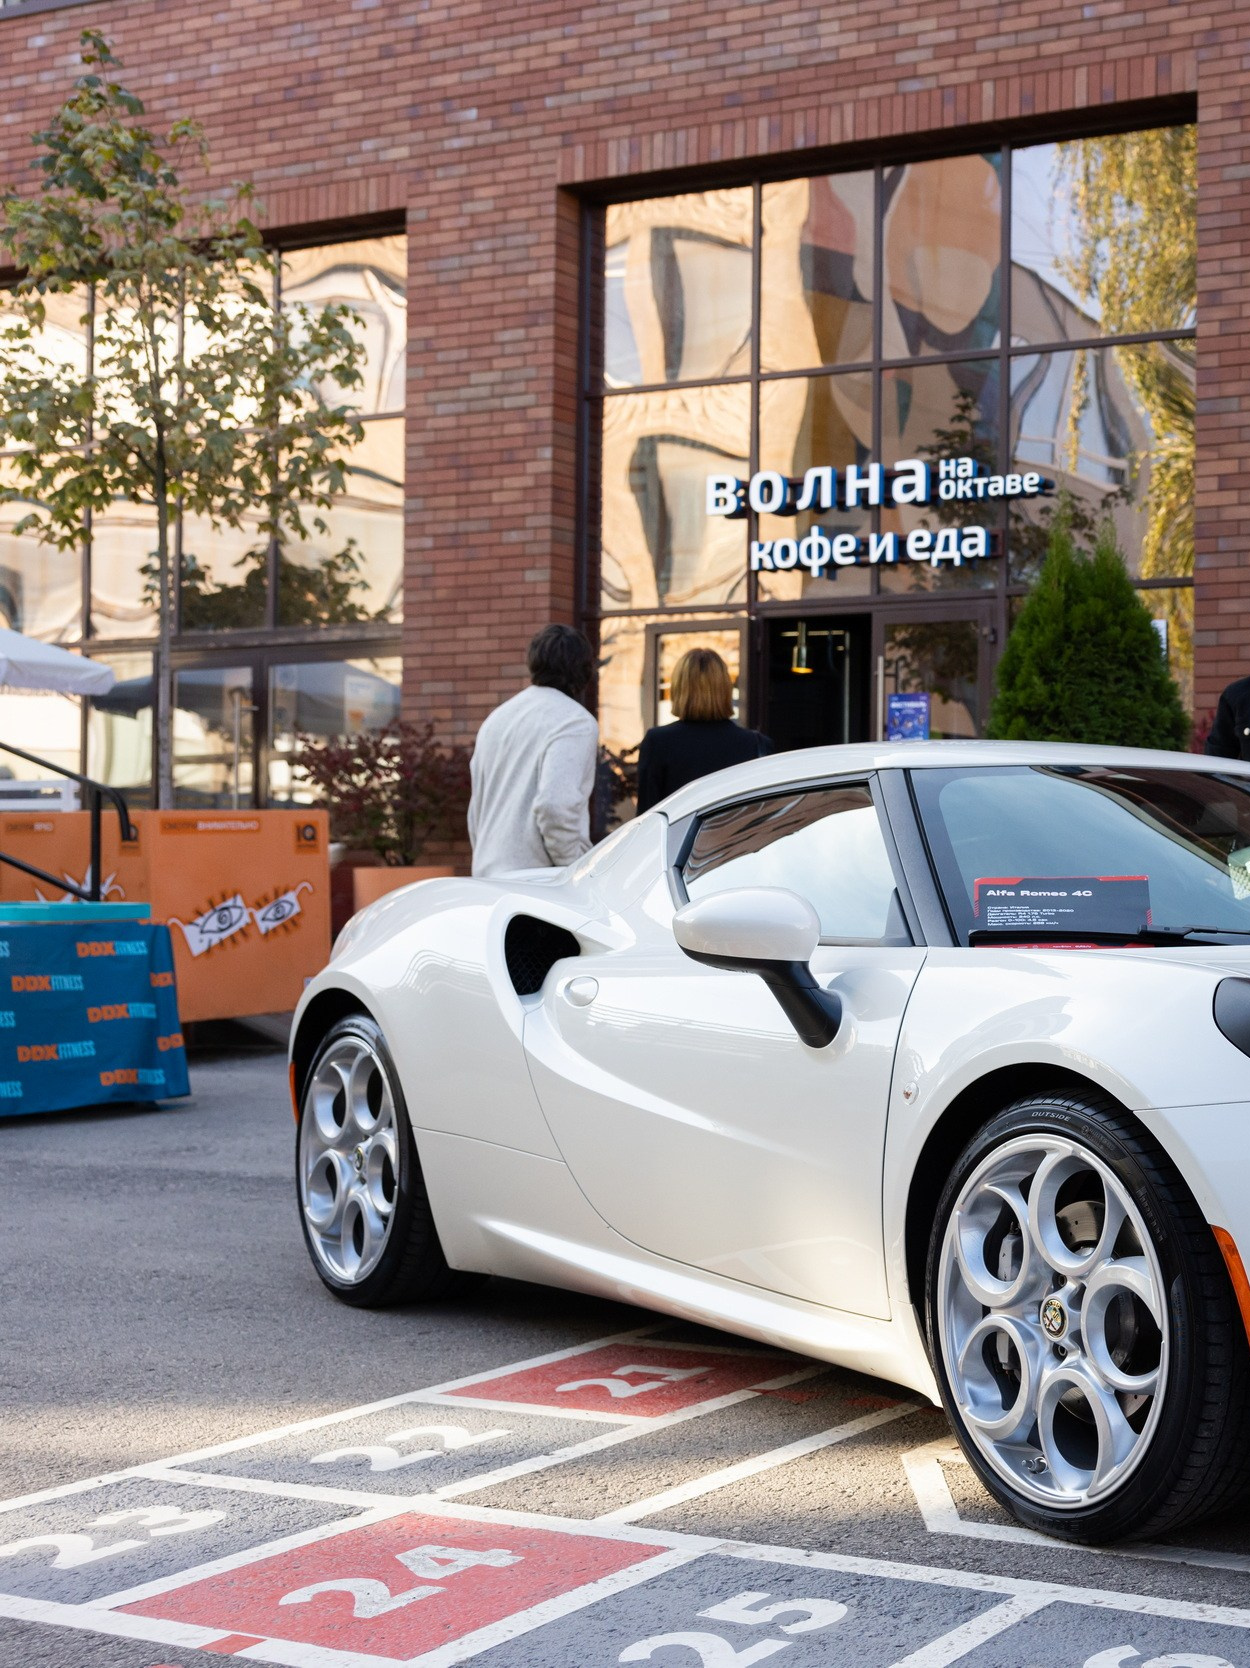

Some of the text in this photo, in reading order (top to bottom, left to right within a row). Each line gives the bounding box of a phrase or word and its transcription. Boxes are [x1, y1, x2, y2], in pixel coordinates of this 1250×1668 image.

[938, 471, 1041, 500] октаве
[751, 525, 989, 577] кофе и еда
[986, 889, 1015, 897] Alfa
[1031, 1111, 1071, 1122] OUTSIDE
[555, 1363, 717, 1398] 21
[309, 1425, 513, 1472] 22
[0, 1505, 227, 1569] 23
[279, 1543, 525, 1619] 24
[618, 1591, 848, 1668] 25
